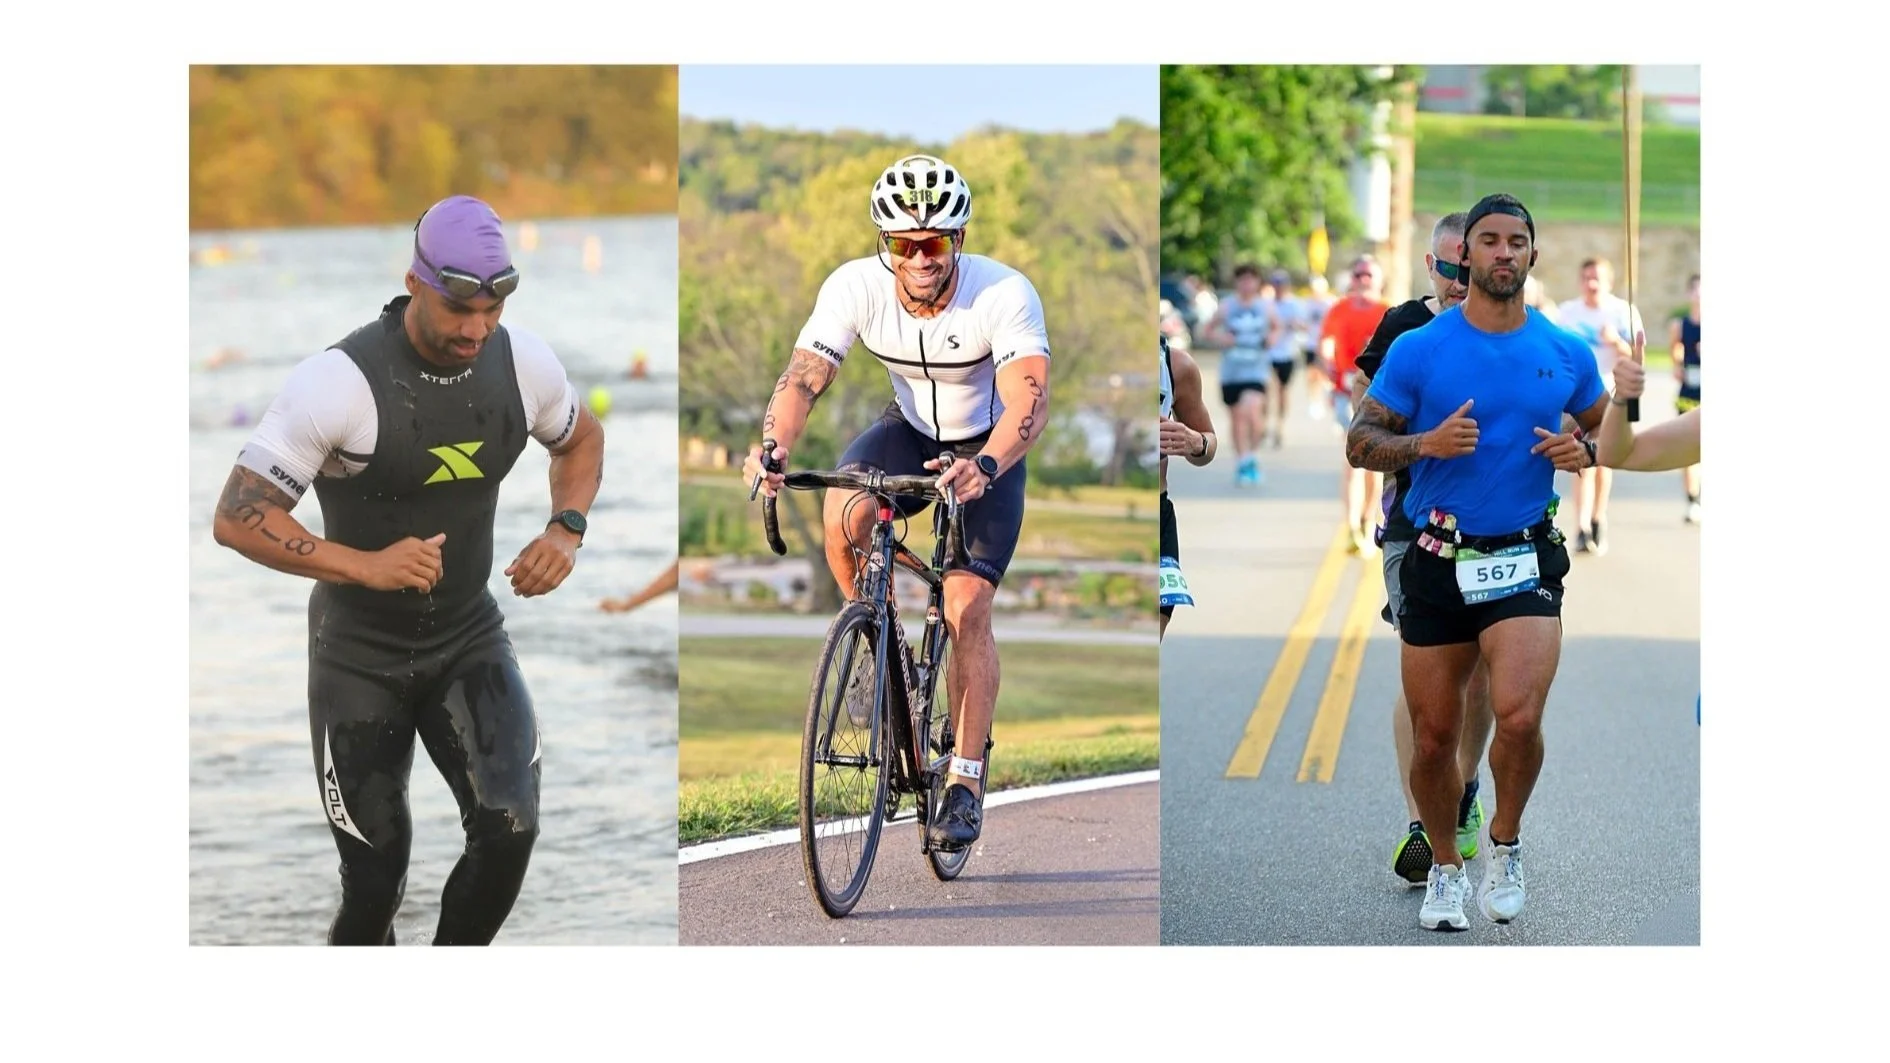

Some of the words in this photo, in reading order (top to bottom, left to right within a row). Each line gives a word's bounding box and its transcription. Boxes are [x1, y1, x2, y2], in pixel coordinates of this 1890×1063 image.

[909, 190, 934, 203] 318
[419, 367, 473, 385] XTERRA
[1018, 375, 1043, 441] 318
[269, 465, 308, 497] syne
[235, 504, 316, 557] 318
[1477, 563, 1518, 582] 567
[1471, 592, 1489, 601] 567
[325, 765, 347, 826] VOLT
